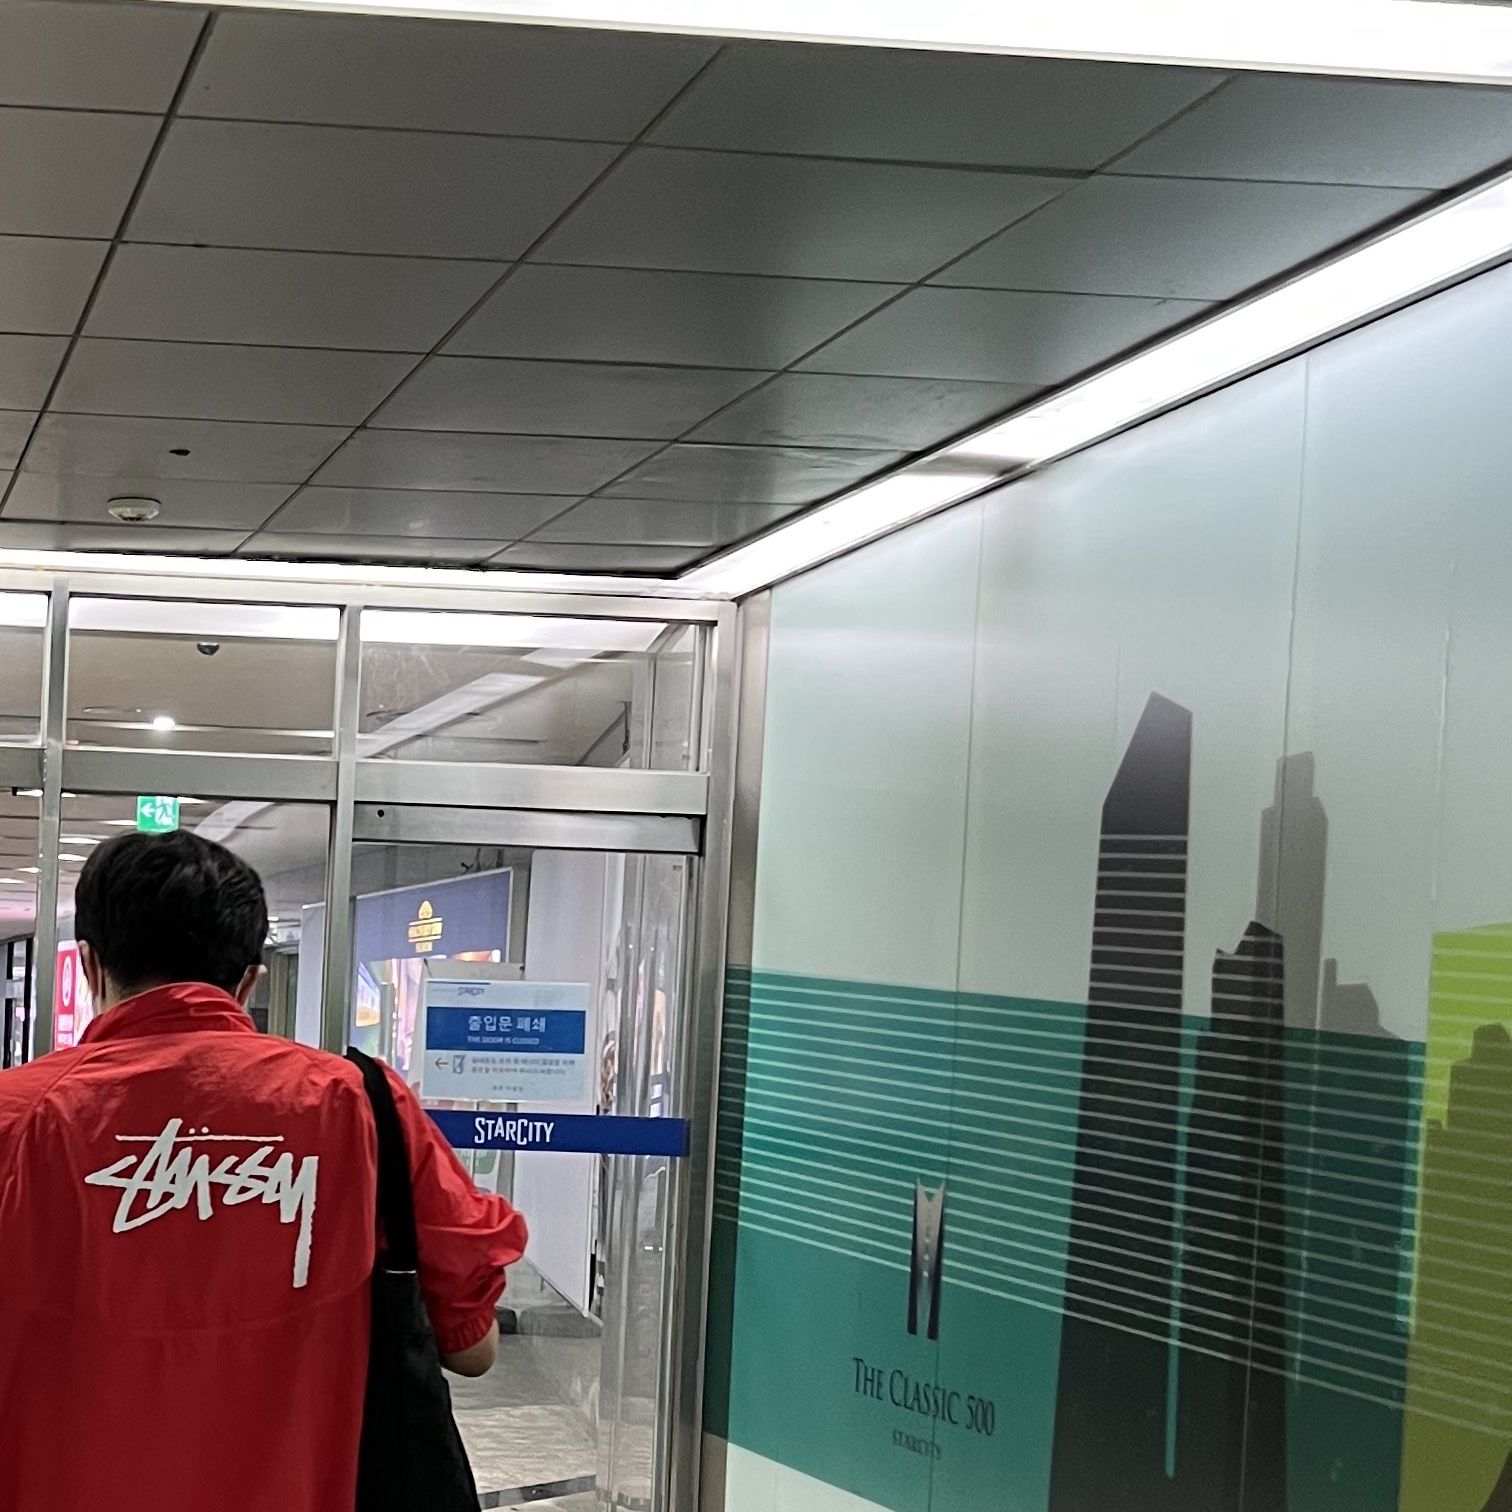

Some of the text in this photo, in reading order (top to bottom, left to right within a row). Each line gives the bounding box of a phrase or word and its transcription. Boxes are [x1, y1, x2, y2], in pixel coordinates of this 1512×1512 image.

[468, 1015, 546, 1033] 출입문 폐쇄
[474, 1117, 554, 1145] STARCITY
[853, 1357, 996, 1437] THE CLASSIC 500
